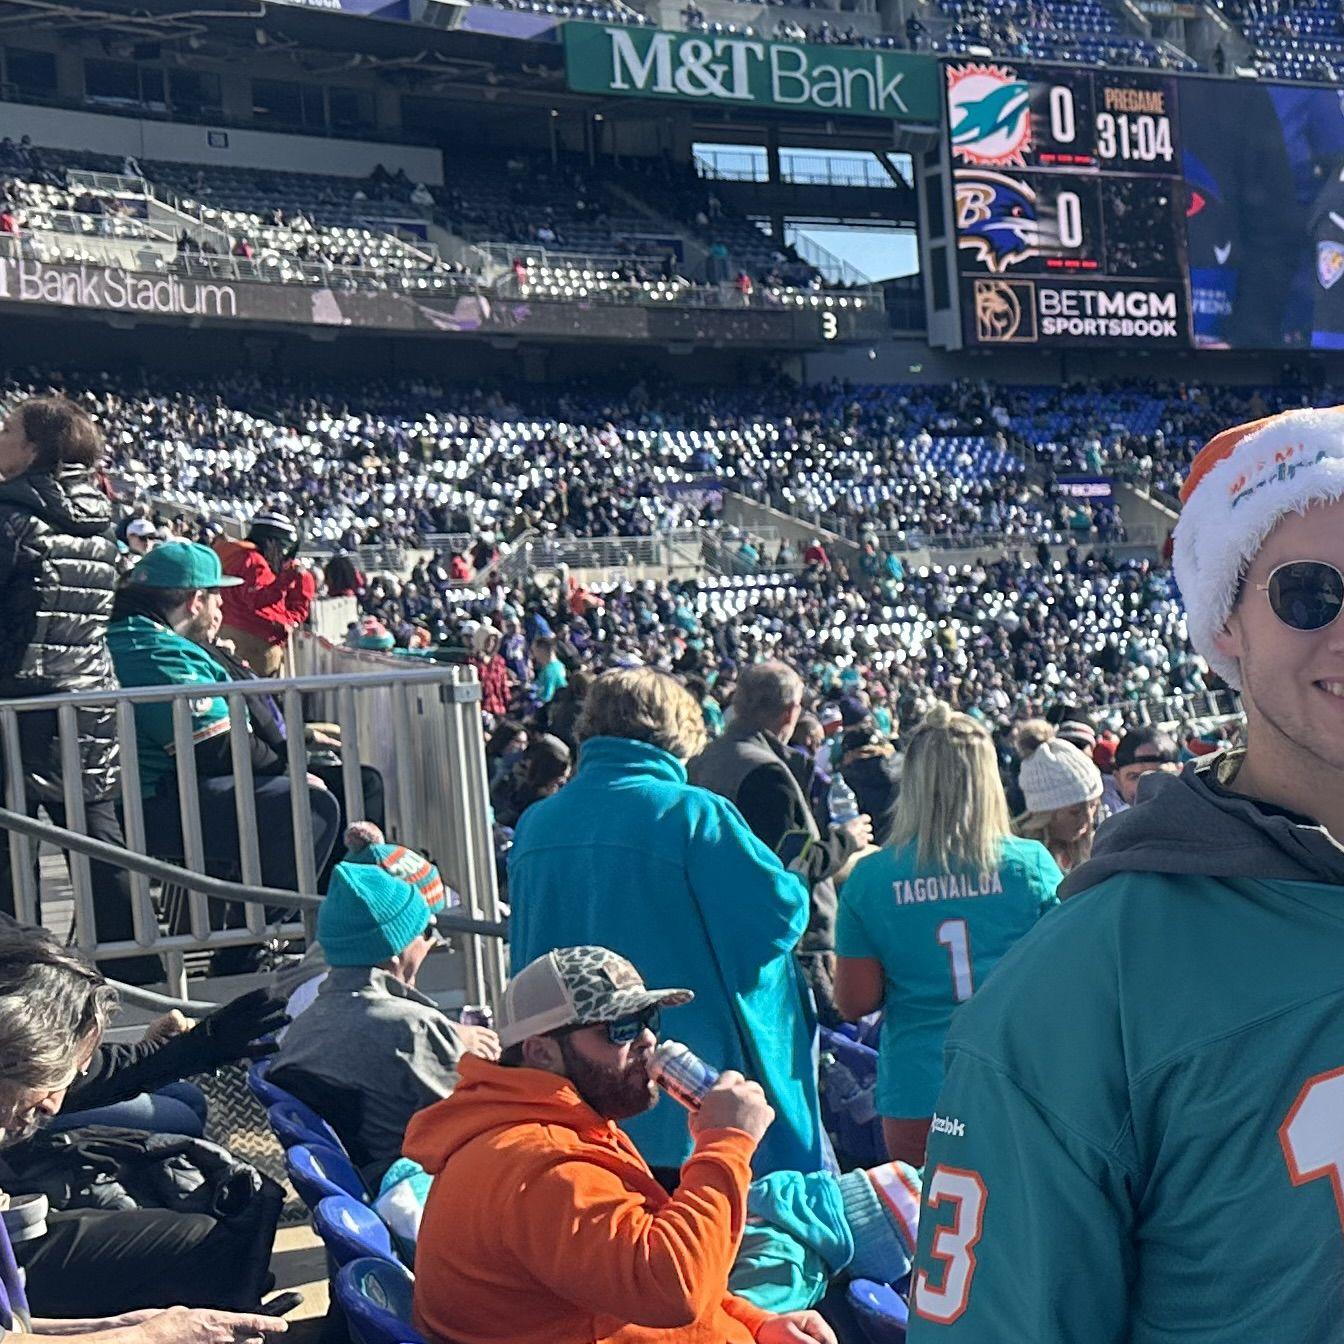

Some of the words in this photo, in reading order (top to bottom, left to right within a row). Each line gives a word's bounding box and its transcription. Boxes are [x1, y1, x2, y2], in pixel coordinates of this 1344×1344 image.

[605, 26, 765, 100] M&T
[770, 45, 909, 113] Bank
[1050, 85, 1076, 143] 0
[1097, 112, 1174, 162] 31:04
[1104, 87, 1165, 114] PREGAME
[1057, 191, 1083, 248] 0
[19, 259, 101, 305] Bank
[104, 267, 237, 316] Stadium
[1039, 289, 1177, 318] BETMGM
[822, 311, 838, 339] 3
[1042, 317, 1177, 337] SPORTSBOOK
[892, 871, 1004, 905] TAGOVAILOA
[935, 917, 974, 1003] 1
[915, 1162, 988, 1325] 3
